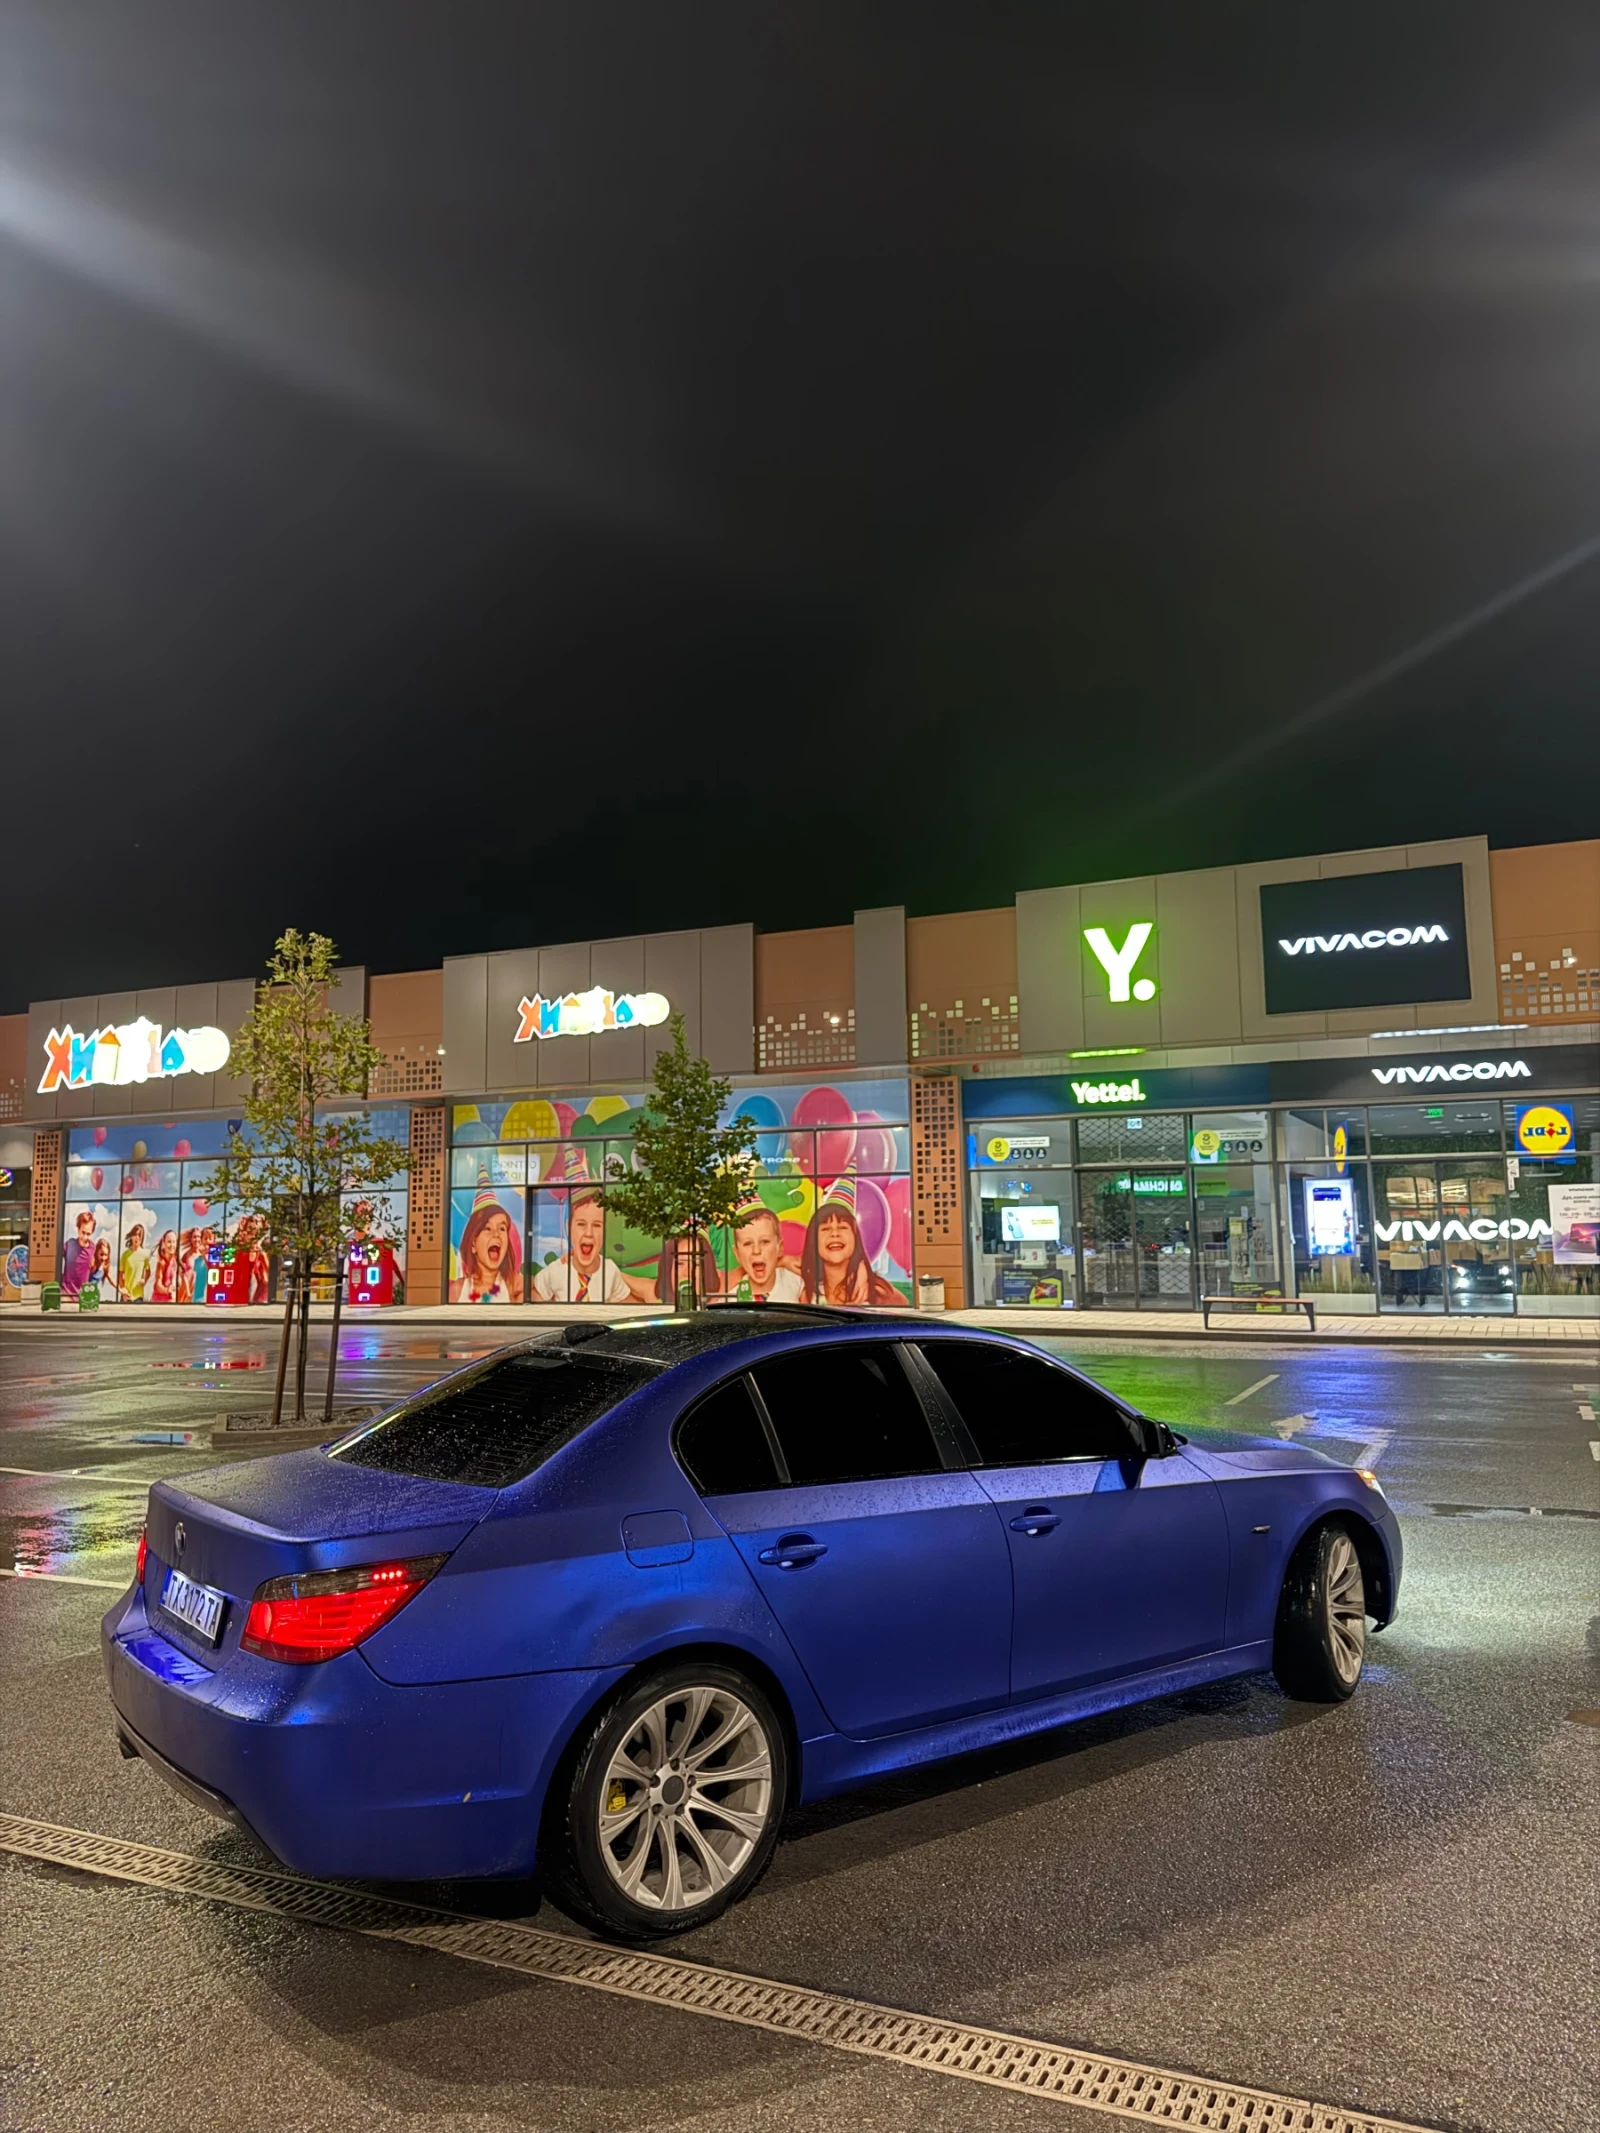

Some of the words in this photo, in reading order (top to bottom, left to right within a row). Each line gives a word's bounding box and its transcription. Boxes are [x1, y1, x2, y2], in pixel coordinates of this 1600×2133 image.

[1278, 924, 1449, 956] VIVACOM
[1371, 1060, 1532, 1085] VIVACOM
[1071, 1079, 1146, 1104] Yettel.
